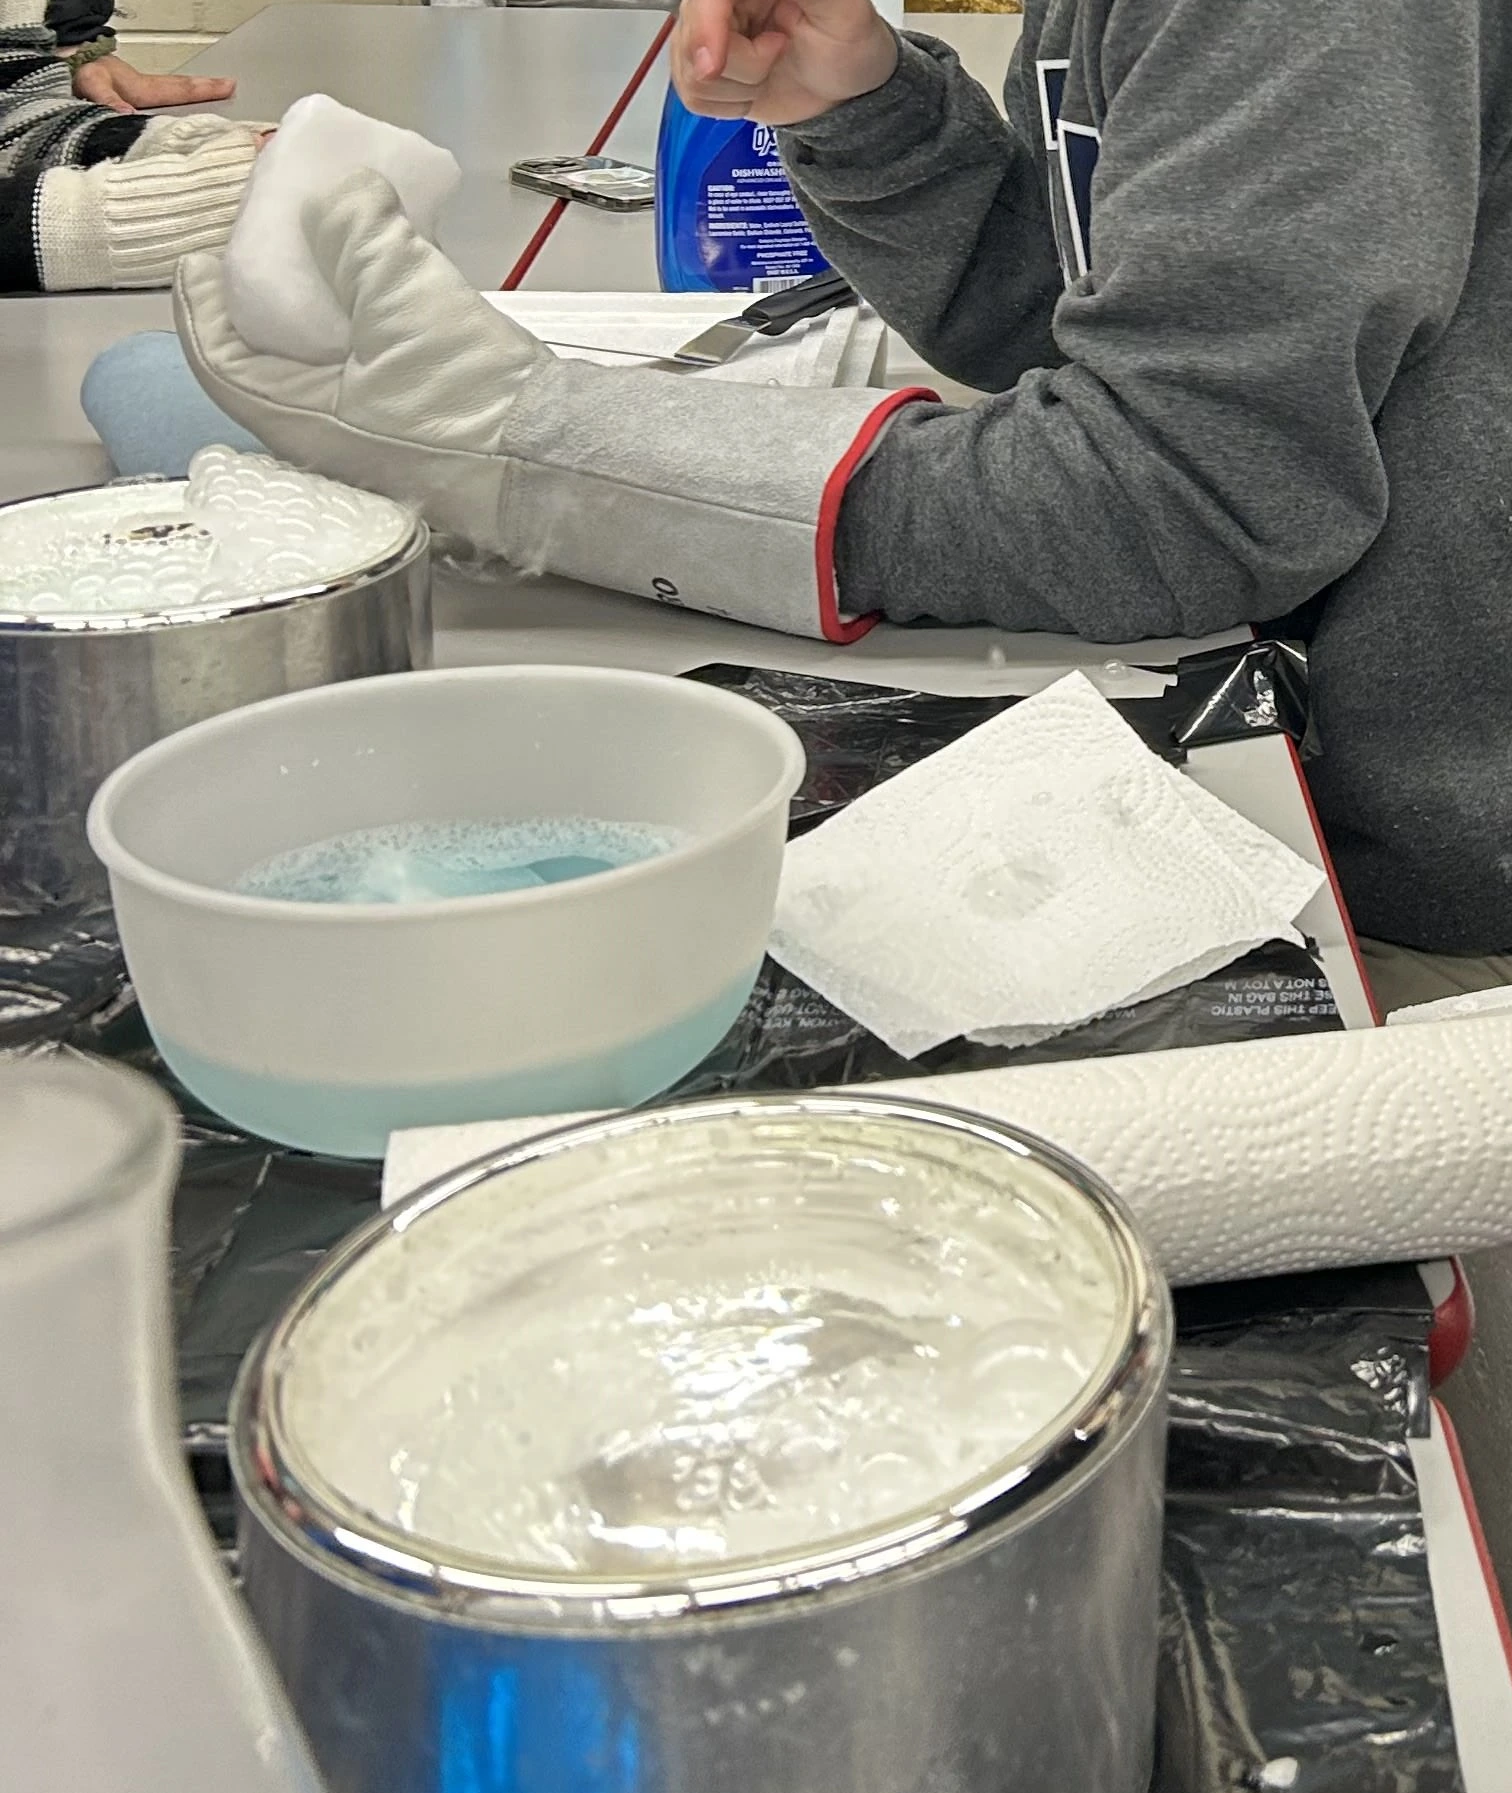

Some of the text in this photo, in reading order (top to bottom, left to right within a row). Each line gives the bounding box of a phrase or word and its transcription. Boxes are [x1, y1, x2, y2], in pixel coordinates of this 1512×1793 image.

[1242, 980, 1271, 991] TOY
[1273, 979, 1285, 989] A
[1286, 978, 1315, 989] NOT
[1228, 990, 1333, 1004] SE THIS BAG IN
[1210, 1003, 1337, 1017] EEP THIS PLASTIC
